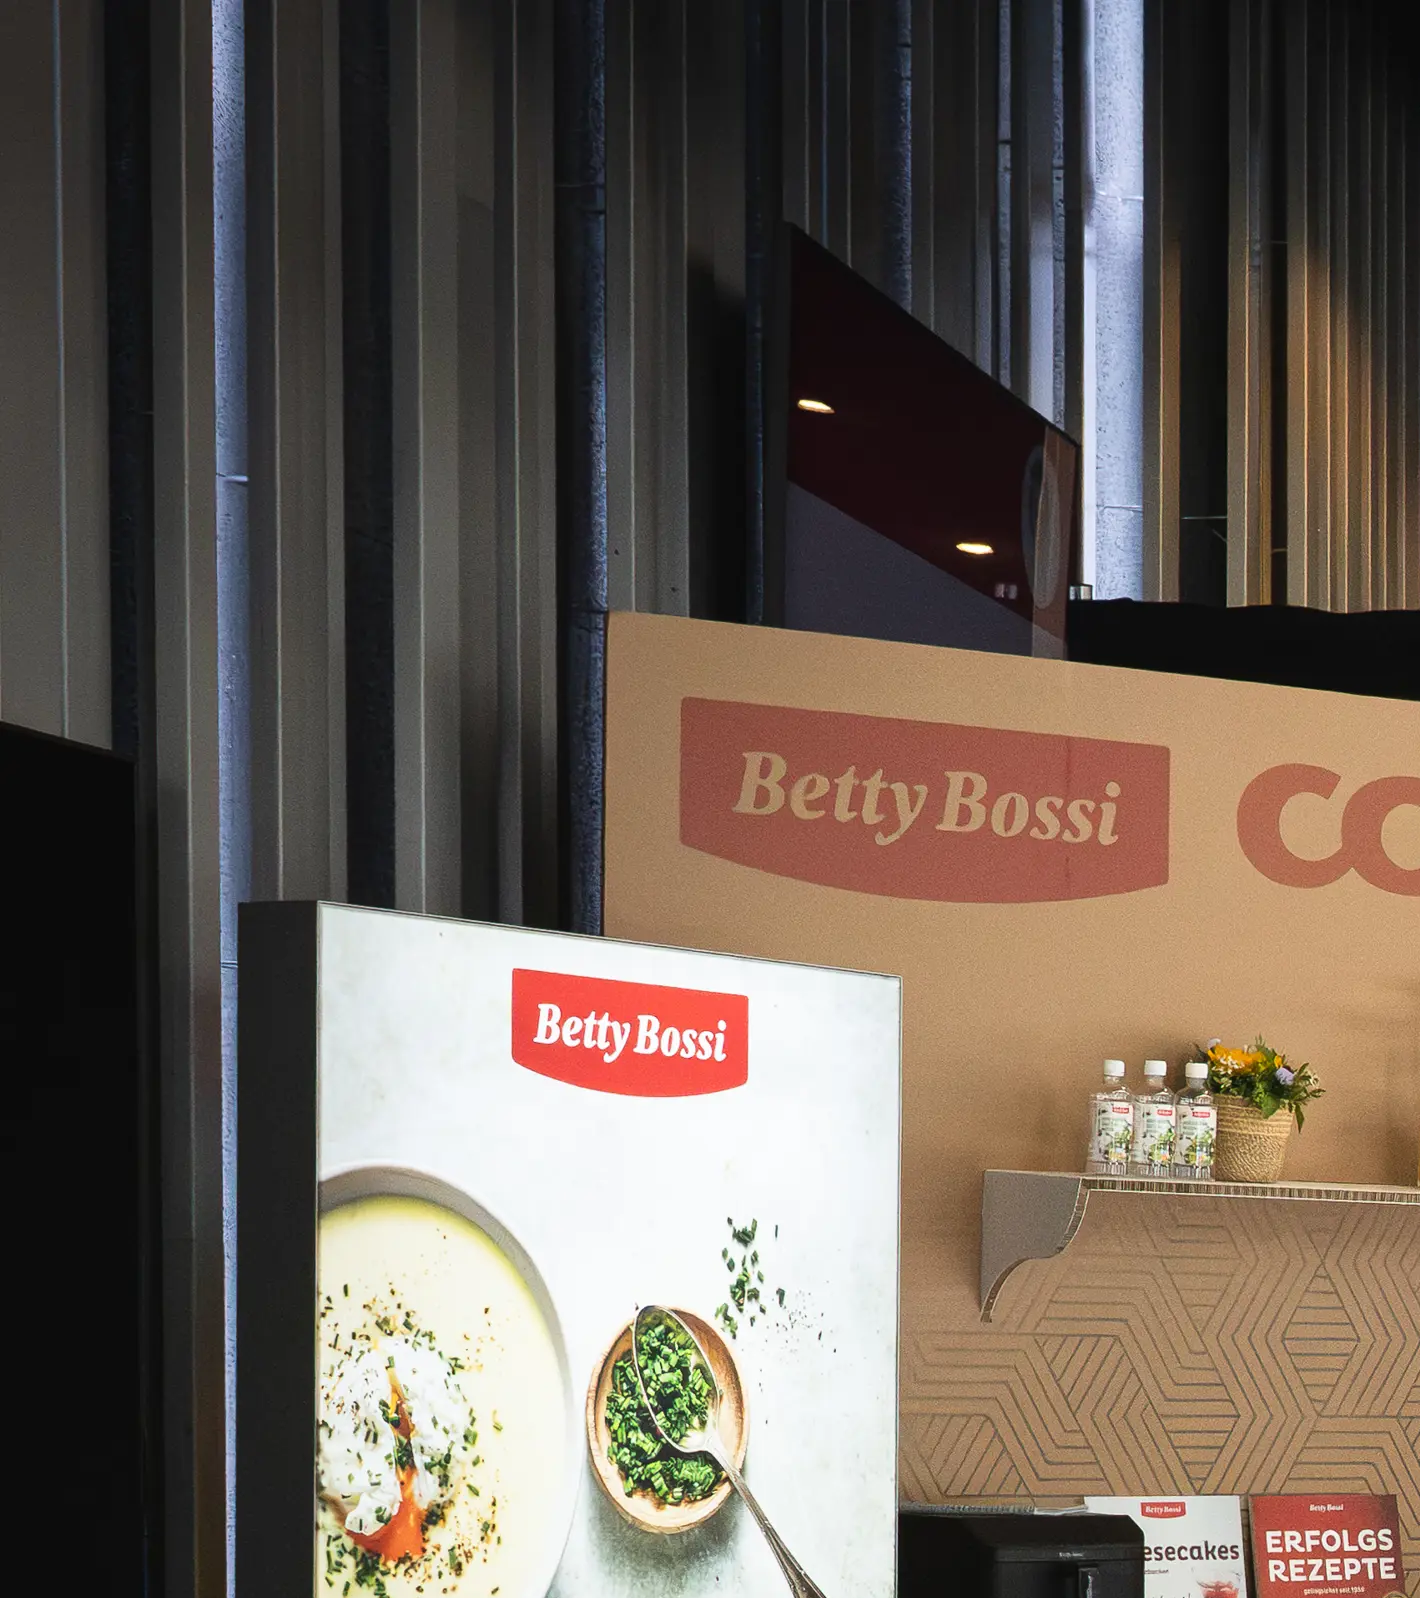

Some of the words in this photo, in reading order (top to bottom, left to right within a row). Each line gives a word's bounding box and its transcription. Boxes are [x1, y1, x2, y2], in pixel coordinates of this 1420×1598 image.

[731, 750, 929, 846] Betty
[936, 769, 1120, 847] Bossi
[532, 1003, 631, 1064] Betty
[632, 1014, 727, 1062] Bossi
[1144, 1540, 1240, 1561] esecakes
[1265, 1528, 1394, 1553] ERFOLGS
[1268, 1557, 1397, 1582] REZEPTE
